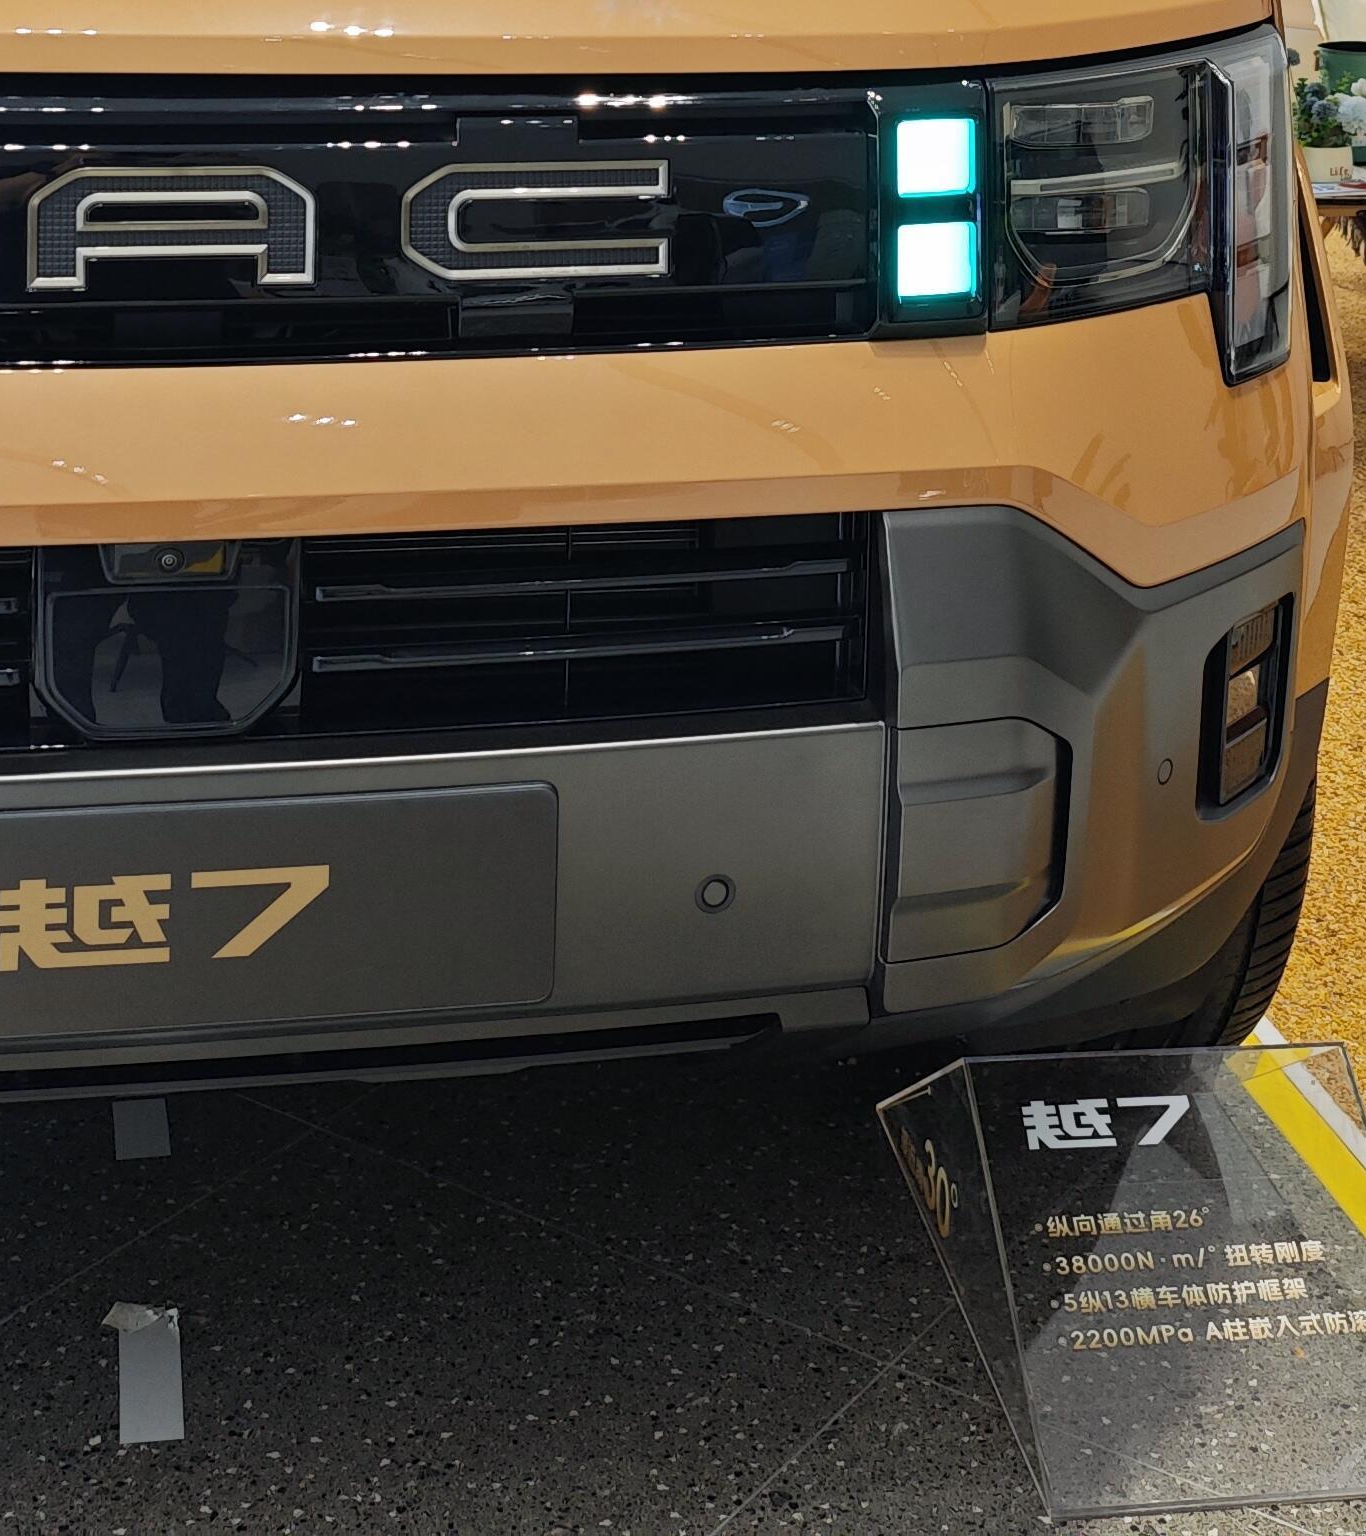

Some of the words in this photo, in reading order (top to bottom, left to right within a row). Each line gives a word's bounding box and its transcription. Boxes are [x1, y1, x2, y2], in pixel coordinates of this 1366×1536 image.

[1021, 1094, 1191, 1151] 越7
[1223, 1239, 1327, 1267] 扭转刚度
[1070, 1323, 1195, 1351] 2200MPa
